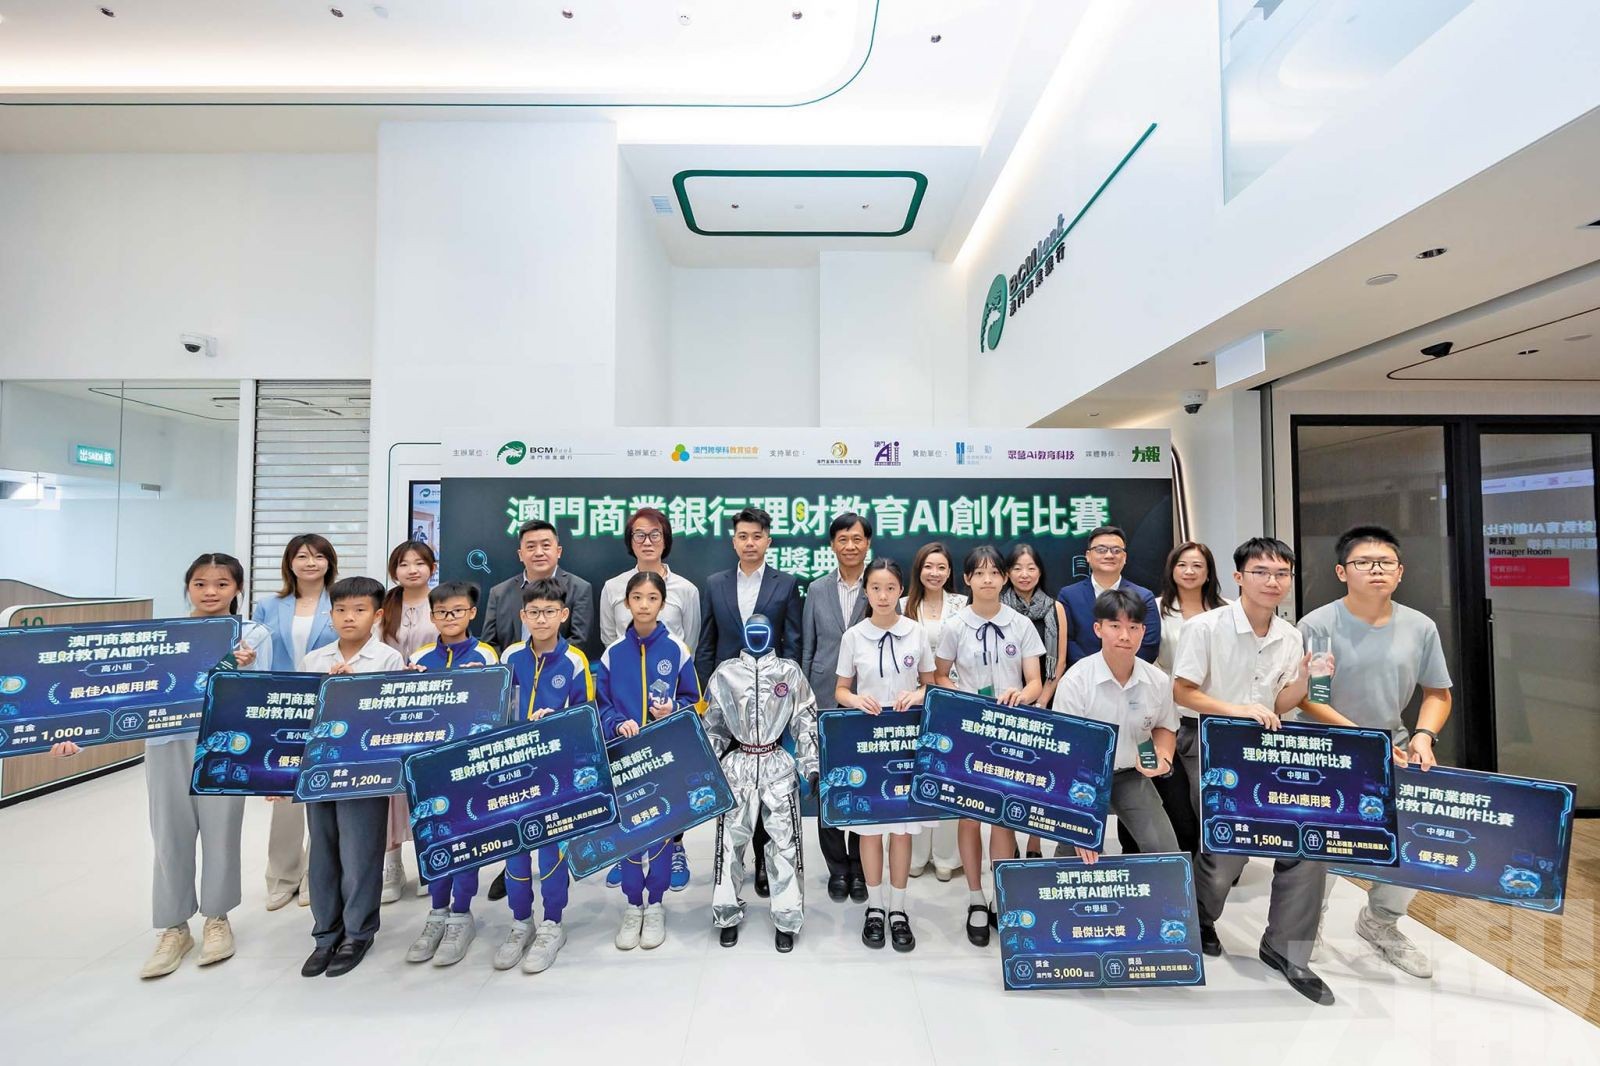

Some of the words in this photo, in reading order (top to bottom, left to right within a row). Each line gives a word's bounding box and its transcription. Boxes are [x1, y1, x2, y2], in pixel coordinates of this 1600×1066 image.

[1009, 247, 1037, 296] BCM
[1131, 446, 1160, 462] 力報
[1488, 547, 1525, 557] Manager
[68, 630, 168, 648] 澳門商業銀行
[38, 641, 191, 664] 理財教育AI創作比賽
[100, 662, 133, 673] 高小組
[69, 679, 160, 699] 最佳AI應用獎
[380, 679, 453, 695] 澳門商業銀行
[266, 692, 318, 705] 澳門商業
[357, 691, 469, 711] 理財教育AI創作比賽
[399, 712, 423, 721] 高小組
[981, 709, 1054, 736] 澳門商業銀行
[13, 723, 36, 734] 獎金
[41, 727, 84, 742] 1,000
[960, 718, 1071, 755] 理財教育AI創作比賽
[369, 729, 447, 747] 最佳理財教育獎
[467, 730, 541, 761] 澳門商業銀行
[1261, 733, 1333, 752] 澳門商業銀行
[450, 739, 562, 782] 理財教育AI創作比賽
[1001, 746, 1024, 759] 中學組
[1243, 747, 1352, 770] 理財教育AI創作比賽
[278, 755, 304, 768] 優秀
[333, 768, 349, 777] 獎金
[498, 769, 522, 782] 高小組
[972, 759, 1048, 789] 最佳理財教育獎
[1286, 771, 1310, 781] 中學組
[350, 775, 381, 787] 1,200
[941, 783, 955, 794] 獎金
[487, 785, 541, 812] 最傑出大獎
[956, 795, 985, 812] 2,000
[1267, 791, 1332, 809] 最佳AI應用獎
[1399, 783, 1492, 808] 澳門商業銀行
[631, 805, 660, 826] 優秀獎
[1234, 823, 1249, 832] 獎金
[1426, 827, 1455, 839] 中學組
[451, 841, 467, 853] 獎金
[471, 839, 502, 858] 1,500
[1253, 834, 1282, 848] 1,500
[1418, 849, 1459, 867] 優秀獎
[1056, 869, 1130, 885] 澳門商業銀行
[1038, 883, 1151, 901] 理財教育AI創作比賽
[1084, 904, 1108, 914] 中學組
[1071, 924, 1127, 939] 最傑出大獎
[1035, 960, 1050, 968] 獎金
[1053, 967, 1083, 980] 3,000
